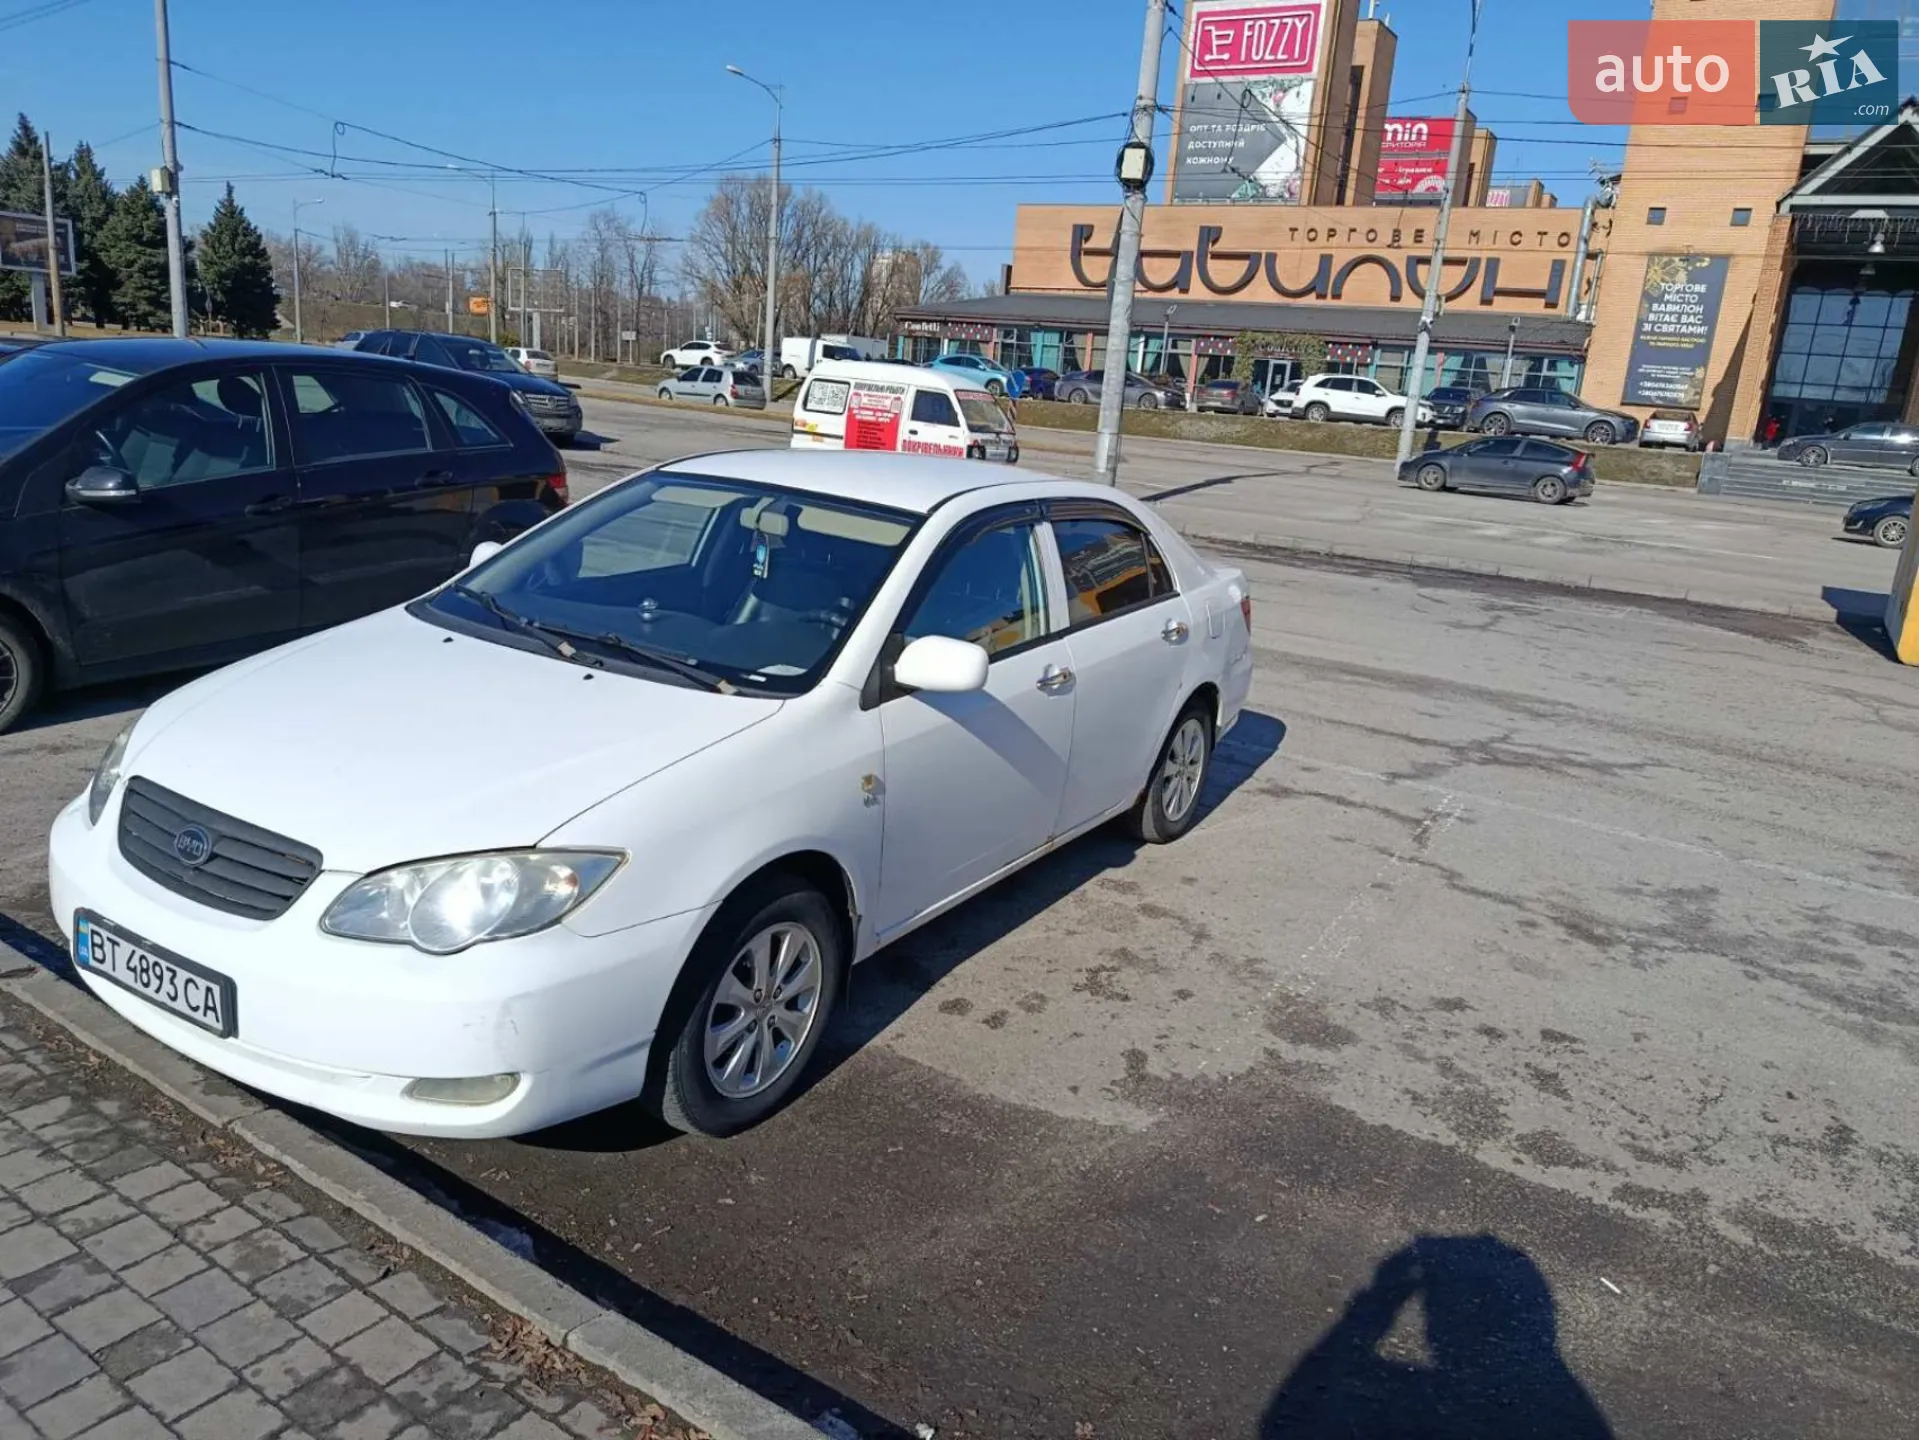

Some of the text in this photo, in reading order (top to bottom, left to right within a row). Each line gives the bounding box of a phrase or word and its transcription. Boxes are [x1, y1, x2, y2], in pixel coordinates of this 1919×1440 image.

[1240, 17, 1308, 61] FOZZY
[1288, 226, 1572, 248] ТОРГОВЕ МІСТО
[1660, 283, 1708, 293] ТОРГОВЕ
[1663, 293, 1698, 303] МІСТО
[1652, 303, 1704, 314] ВАВИЛОН
[1680, 315, 1704, 324] ВАС
[126, 949, 179, 1003] 4893
